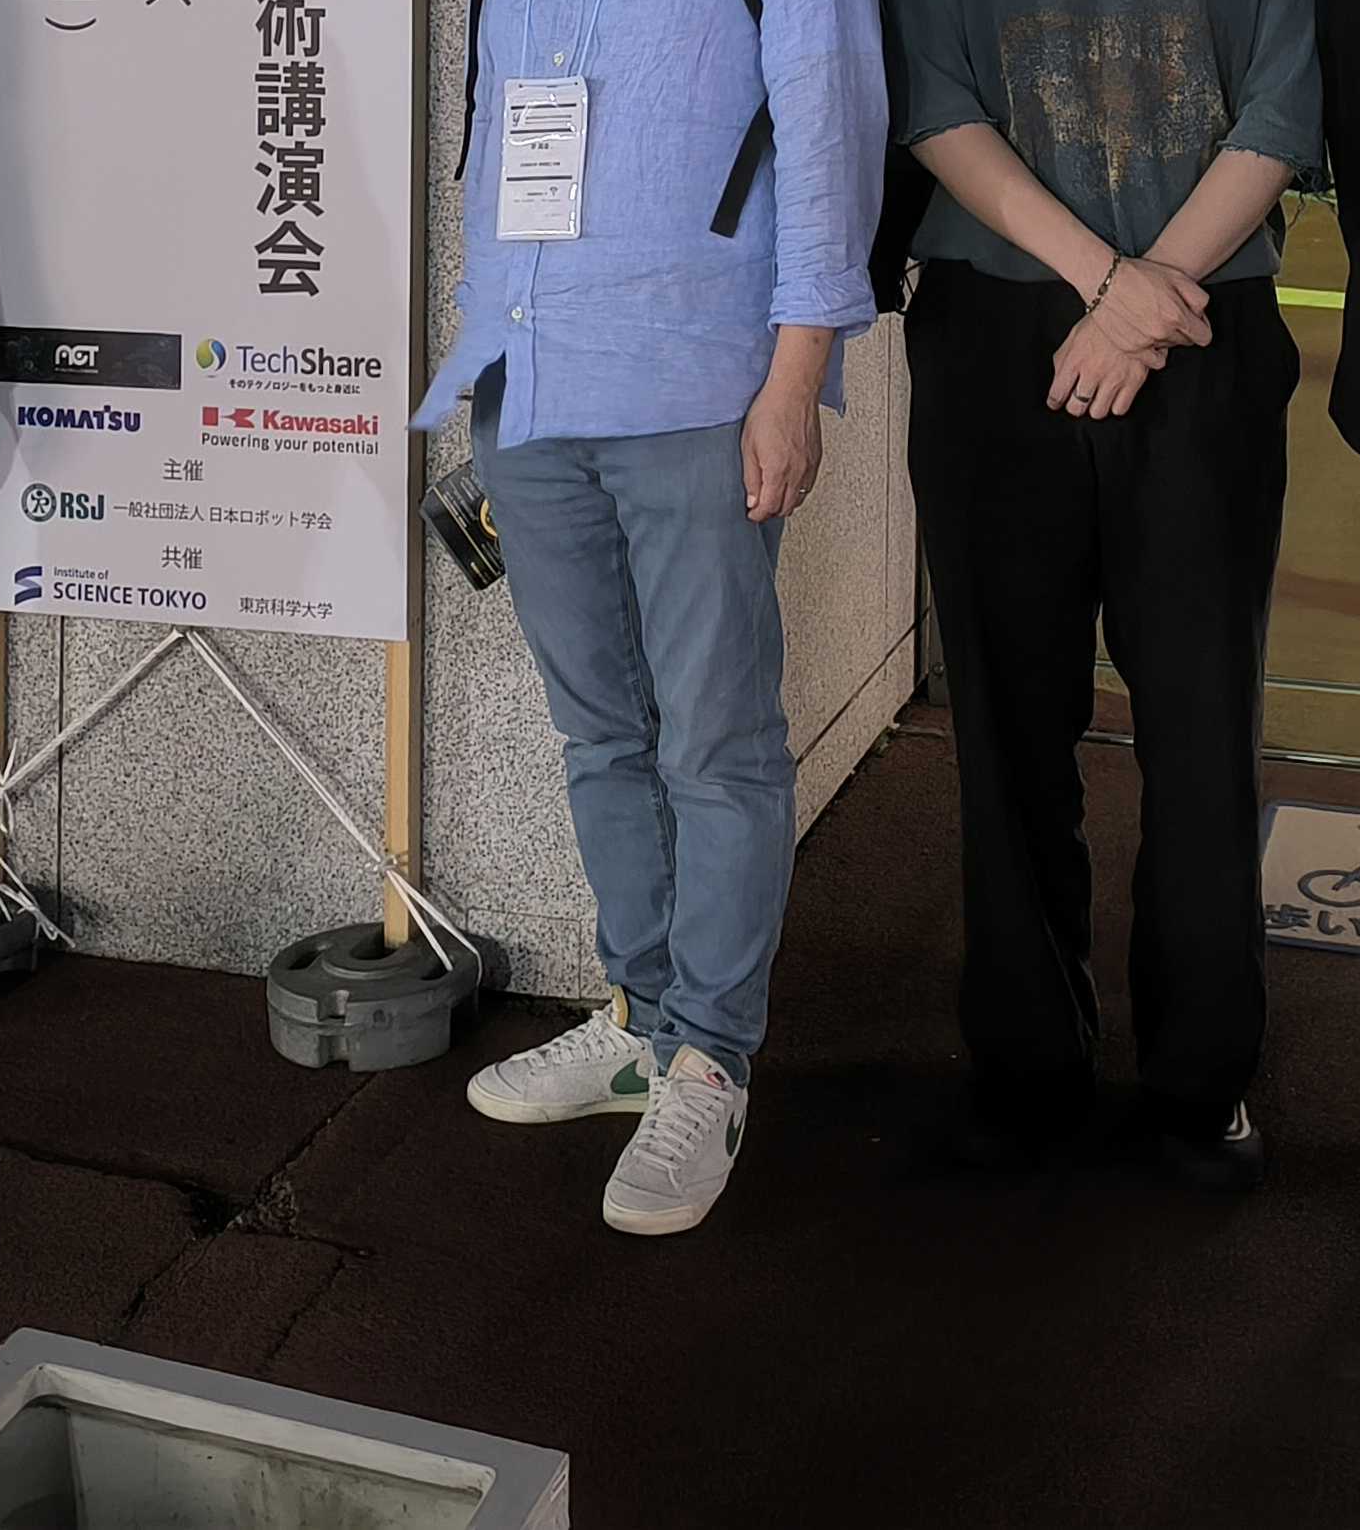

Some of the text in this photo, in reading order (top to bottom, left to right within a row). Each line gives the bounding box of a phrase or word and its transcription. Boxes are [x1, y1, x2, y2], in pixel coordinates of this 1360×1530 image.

[236, 346, 382, 378] TechShare
[230, 378, 360, 395] そのテクノロジーをもっと身近に
[18, 405, 141, 432] KOMATSU
[263, 409, 379, 435] Kawasaki
[202, 433, 378, 455] Powering your potential
[163, 458, 204, 481] 主催
[60, 492, 105, 520] RSJ
[113, 501, 332, 530] 一般社団法人 日本ロボット学会
[161, 545, 203, 570] 共催
[53, 567, 108, 580] Institute of
[53, 582, 207, 610] SCIENCE TOKYO
[240, 597, 333, 619] 東京科学大学
